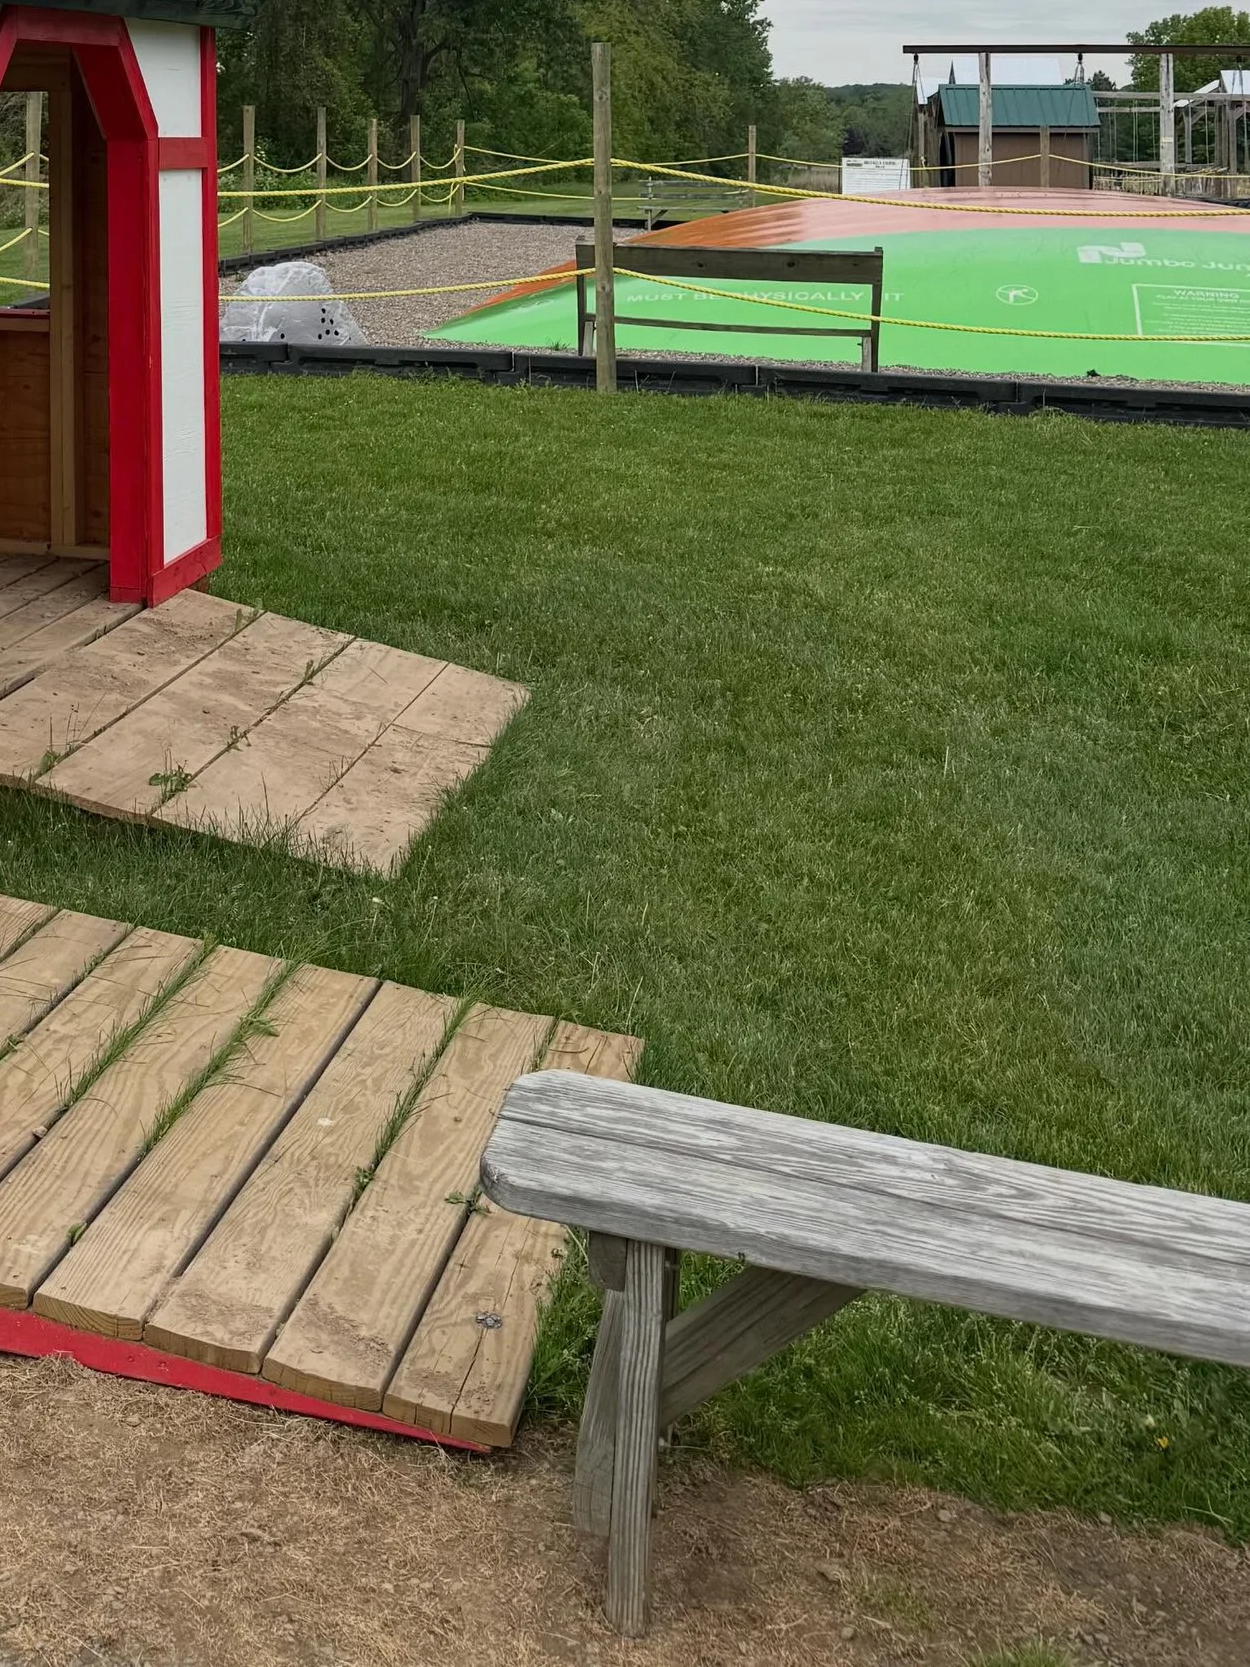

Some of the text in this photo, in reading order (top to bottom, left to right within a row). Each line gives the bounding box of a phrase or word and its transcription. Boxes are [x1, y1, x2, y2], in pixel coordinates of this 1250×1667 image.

[1105, 256, 1196, 268] Jumbo
[627, 293, 687, 302] MUST
[732, 291, 864, 301] HYSICALLY
[1174, 289, 1240, 299] WARNING
